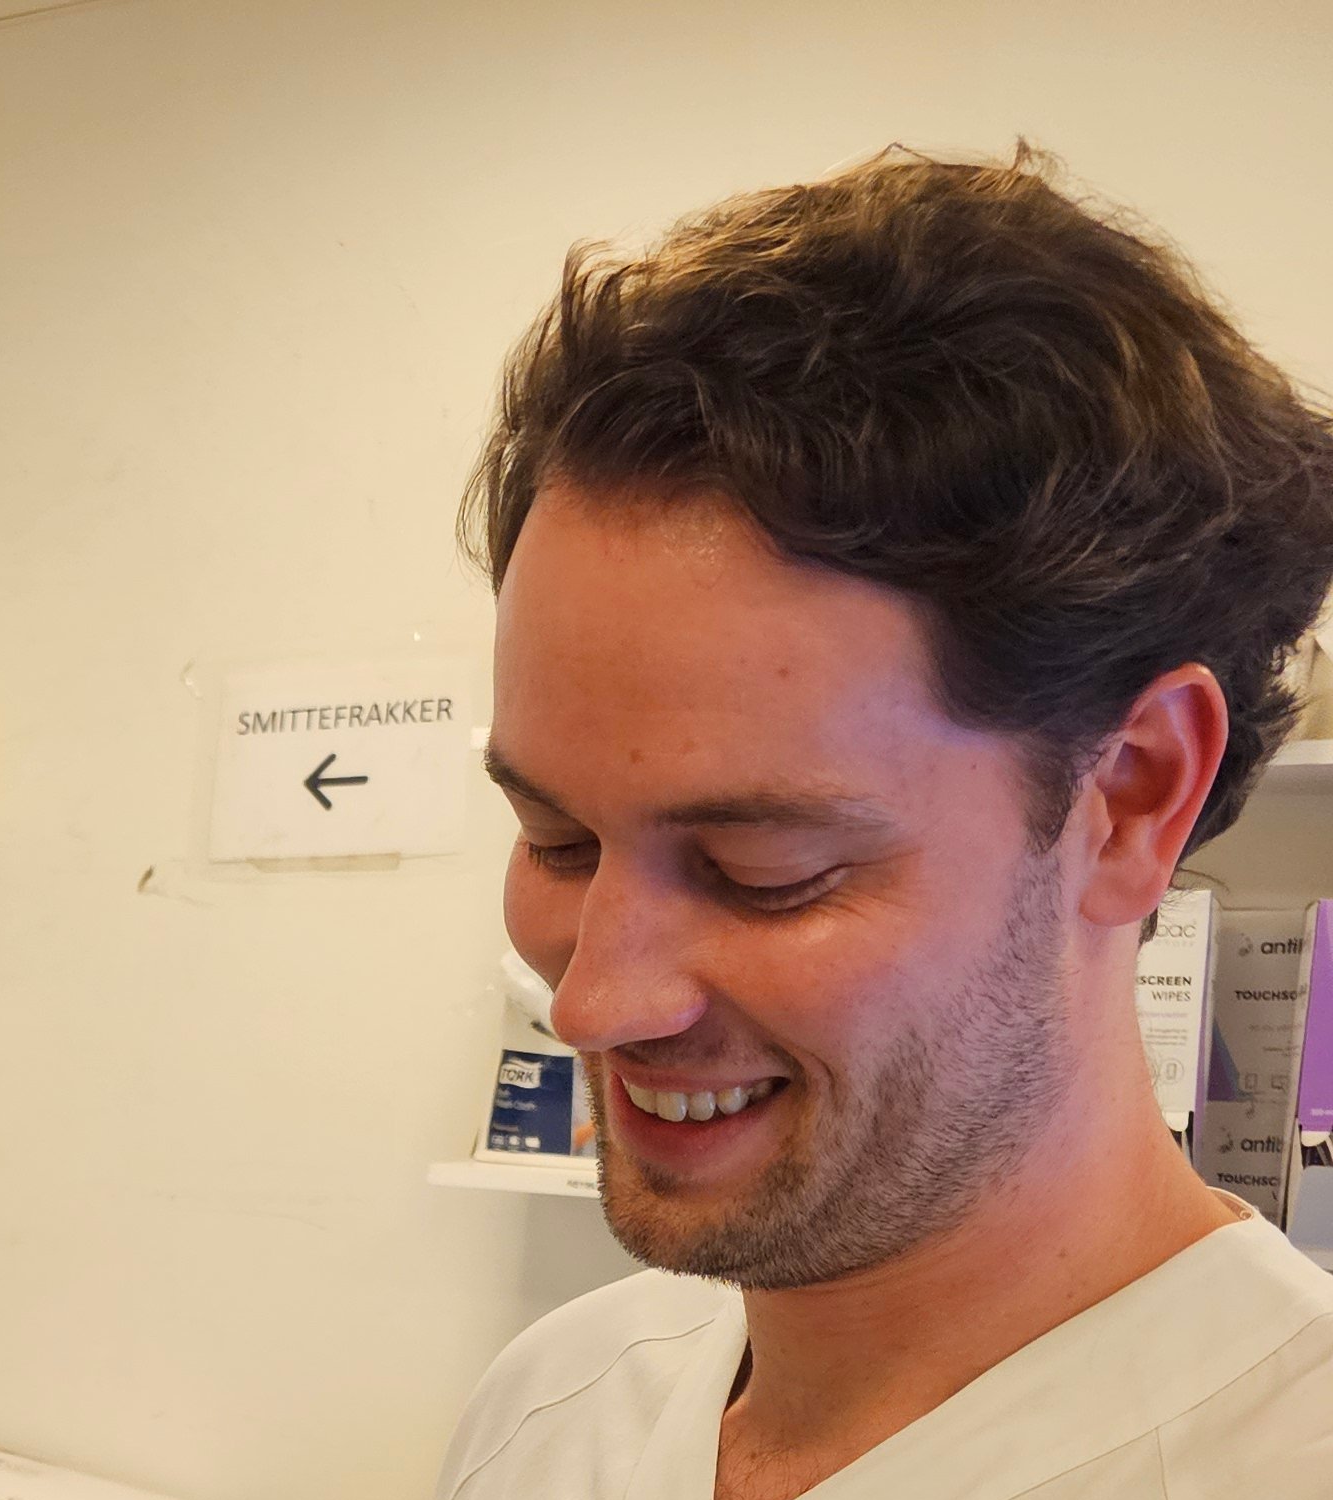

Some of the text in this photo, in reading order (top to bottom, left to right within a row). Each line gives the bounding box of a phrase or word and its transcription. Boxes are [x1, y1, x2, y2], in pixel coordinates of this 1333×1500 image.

[236, 698, 453, 735] SMITTEFRAKKER
[1260, 937, 1304, 955] anti
[1136, 975, 1192, 987] SCREEN
[1151, 990, 1192, 1002] WIPES
[501, 1067, 534, 1083] TORK
[1216, 1172, 1279, 1187] TOUCHSC
